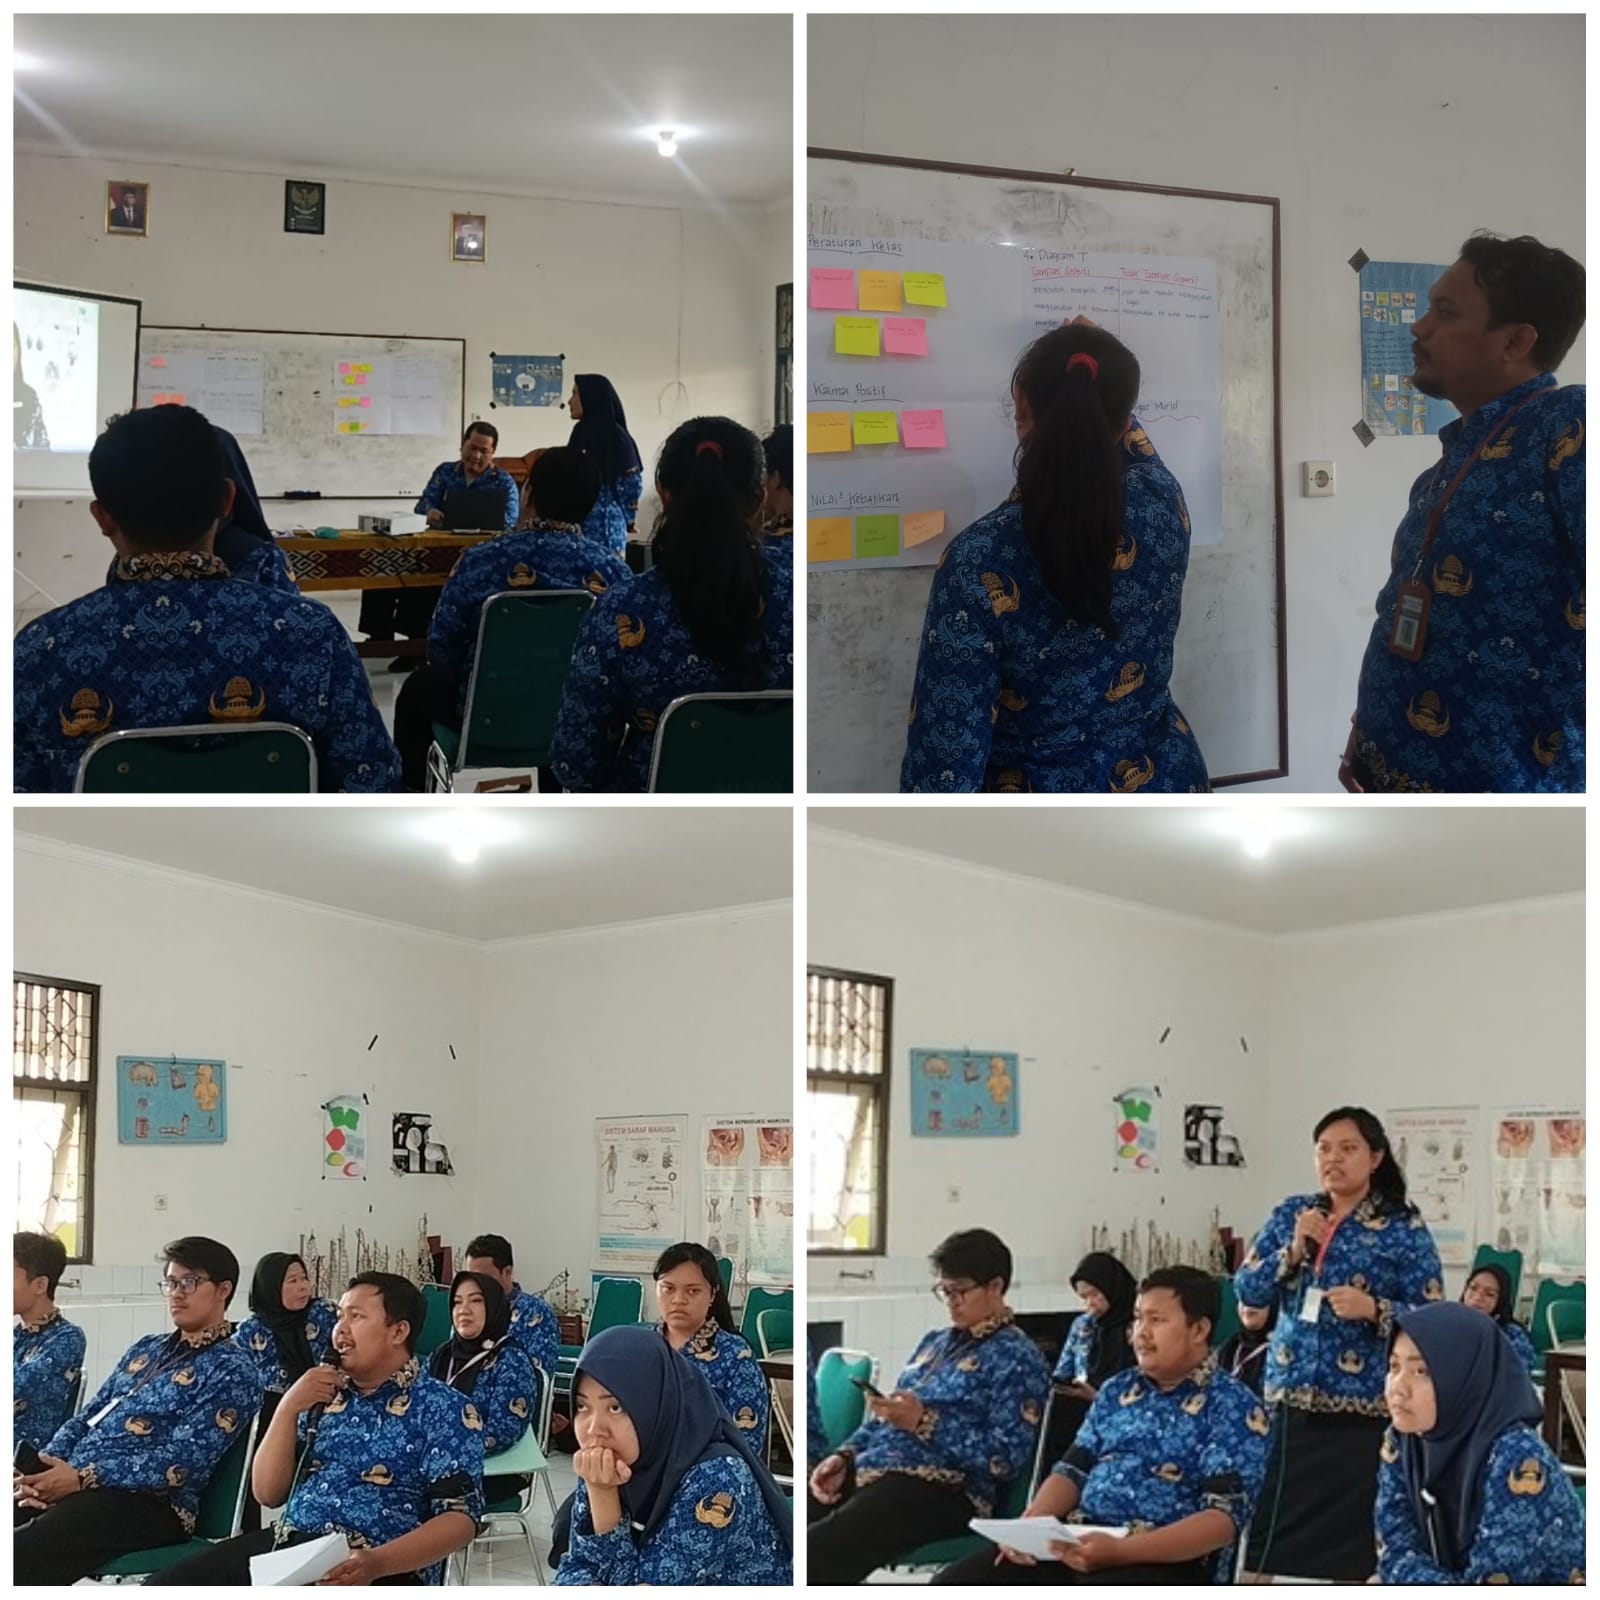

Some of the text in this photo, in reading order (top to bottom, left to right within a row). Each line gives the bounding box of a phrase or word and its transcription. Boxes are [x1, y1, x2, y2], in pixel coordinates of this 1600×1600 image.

[807, 234, 902, 252] Peraturan Kelas
[1038, 248, 1075, 262] Diagram
[1078, 252, 1088, 262] T
[856, 382, 886, 397] Positif
[1154, 399, 1178, 410] Murid
[848, 492, 901, 506] Kebajikan
